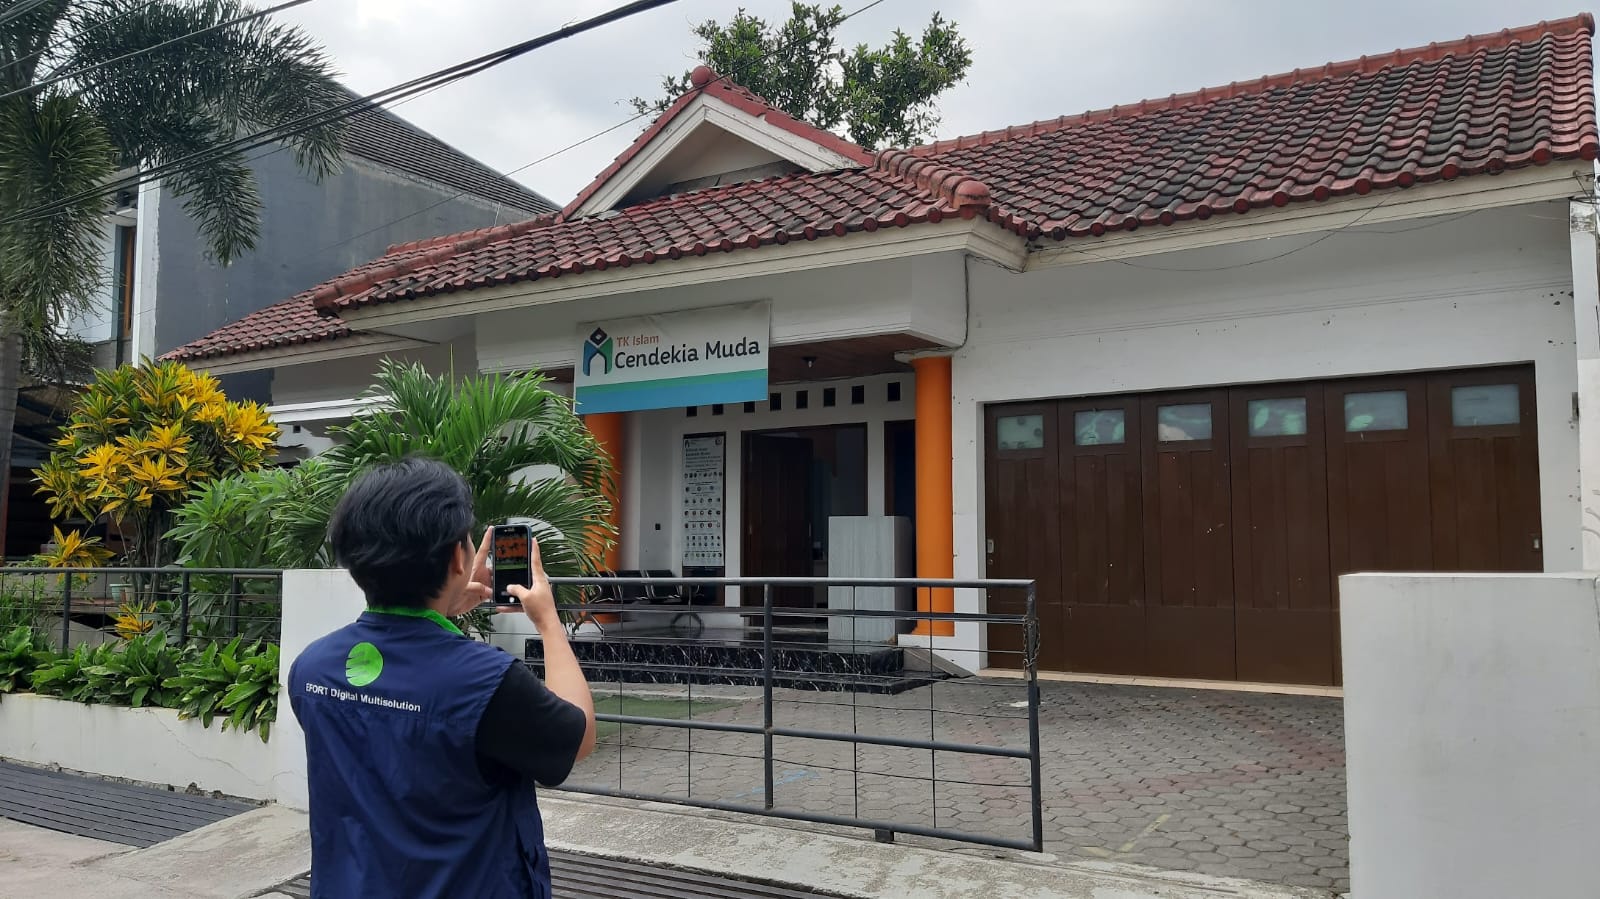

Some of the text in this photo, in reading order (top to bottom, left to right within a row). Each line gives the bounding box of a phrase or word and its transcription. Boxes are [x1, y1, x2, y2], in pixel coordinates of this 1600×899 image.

[615, 336, 761, 369] Cendekia Muda
[617, 334, 660, 348] TK Islam
[305, 683, 421, 712] EFORT Digital Multisolution
